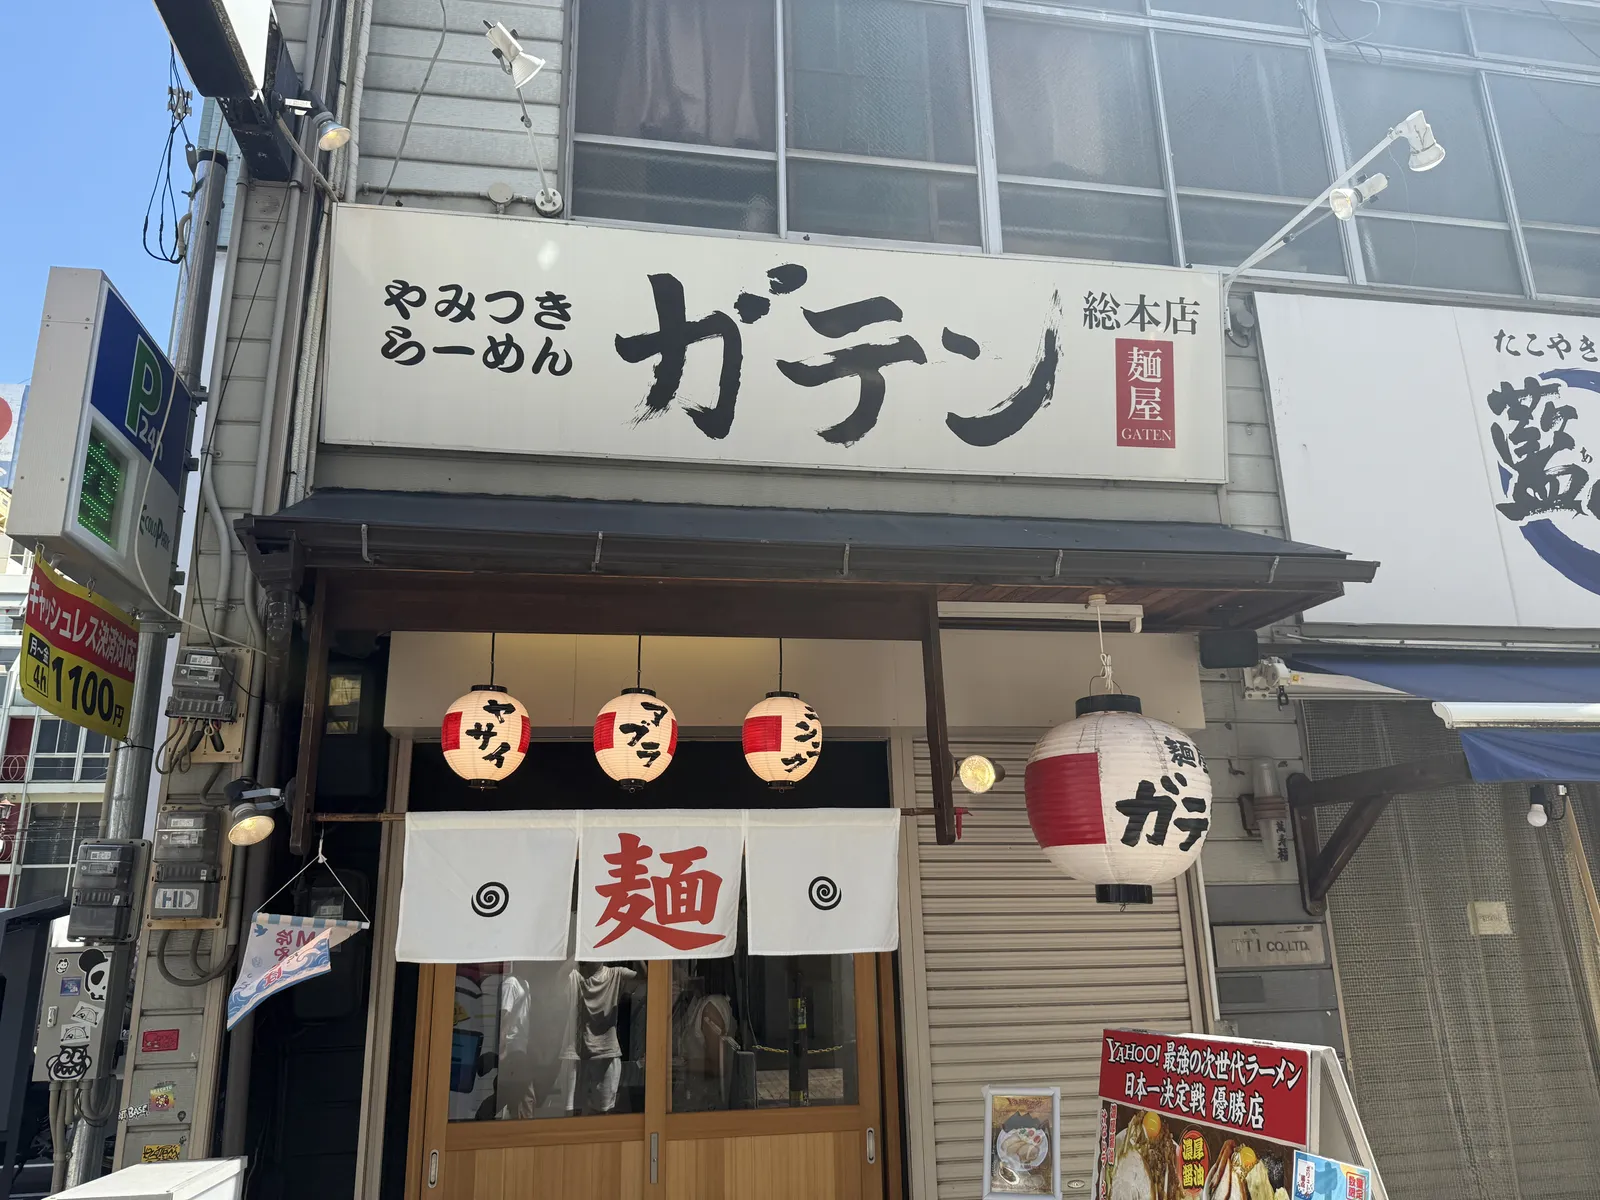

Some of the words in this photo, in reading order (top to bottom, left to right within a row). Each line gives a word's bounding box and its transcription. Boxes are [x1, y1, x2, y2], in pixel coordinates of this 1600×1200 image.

[384, 279, 572, 330] やみつき
[1082, 290, 1201, 335] 総本店
[381, 325, 573, 377] らーめん
[614, 263, 1063, 448] ガテン
[1494, 328, 1599, 363] たこやき
[125, 333, 163, 438] P
[1126, 346, 1163, 422] 麺屋
[139, 416, 163, 462] 24h
[1121, 427, 1172, 442] GATEN
[1487, 376, 1600, 522] 藍
[29, 576, 138, 673] キャッシュレス決済対応
[33, 664, 47, 694] 4h
[52, 656, 125, 728] 1100円
[466, 699, 515, 769] ヤサイ
[619, 701, 668, 768] アブラ
[592, 832, 726, 950] 麺
[1106, 1037, 1161, 1067] YAHOO!
[1163, 1041, 1303, 1090] 最強の次世代ラーメン
[1125, 1071, 1206, 1117] 日本一決定戦
[1210, 1086, 1265, 1130] 優勝店
